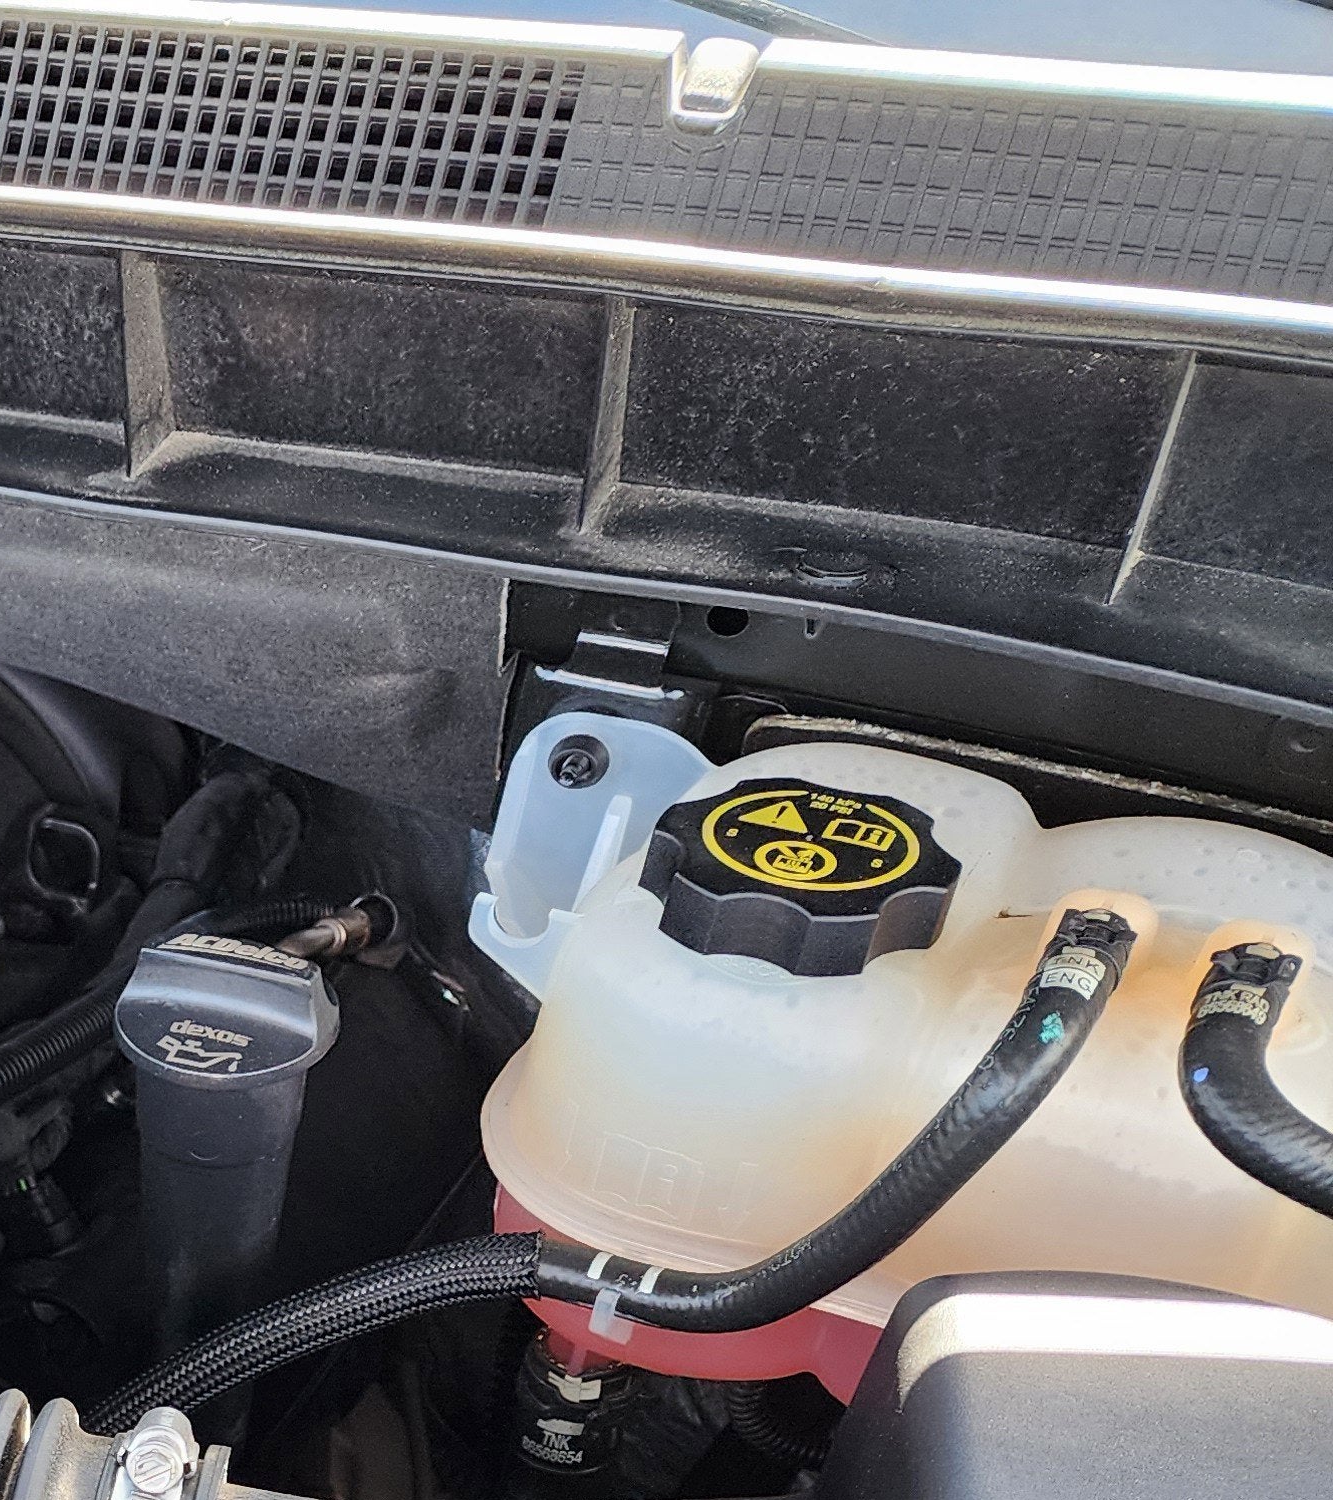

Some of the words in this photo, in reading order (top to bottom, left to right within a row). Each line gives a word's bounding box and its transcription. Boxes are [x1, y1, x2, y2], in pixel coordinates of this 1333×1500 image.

[165, 932, 310, 970] ACDelco
[1044, 970, 1093, 993] ENG
[170, 1020, 254, 1047] dexos
[542, 1429, 572, 1450] TNK
